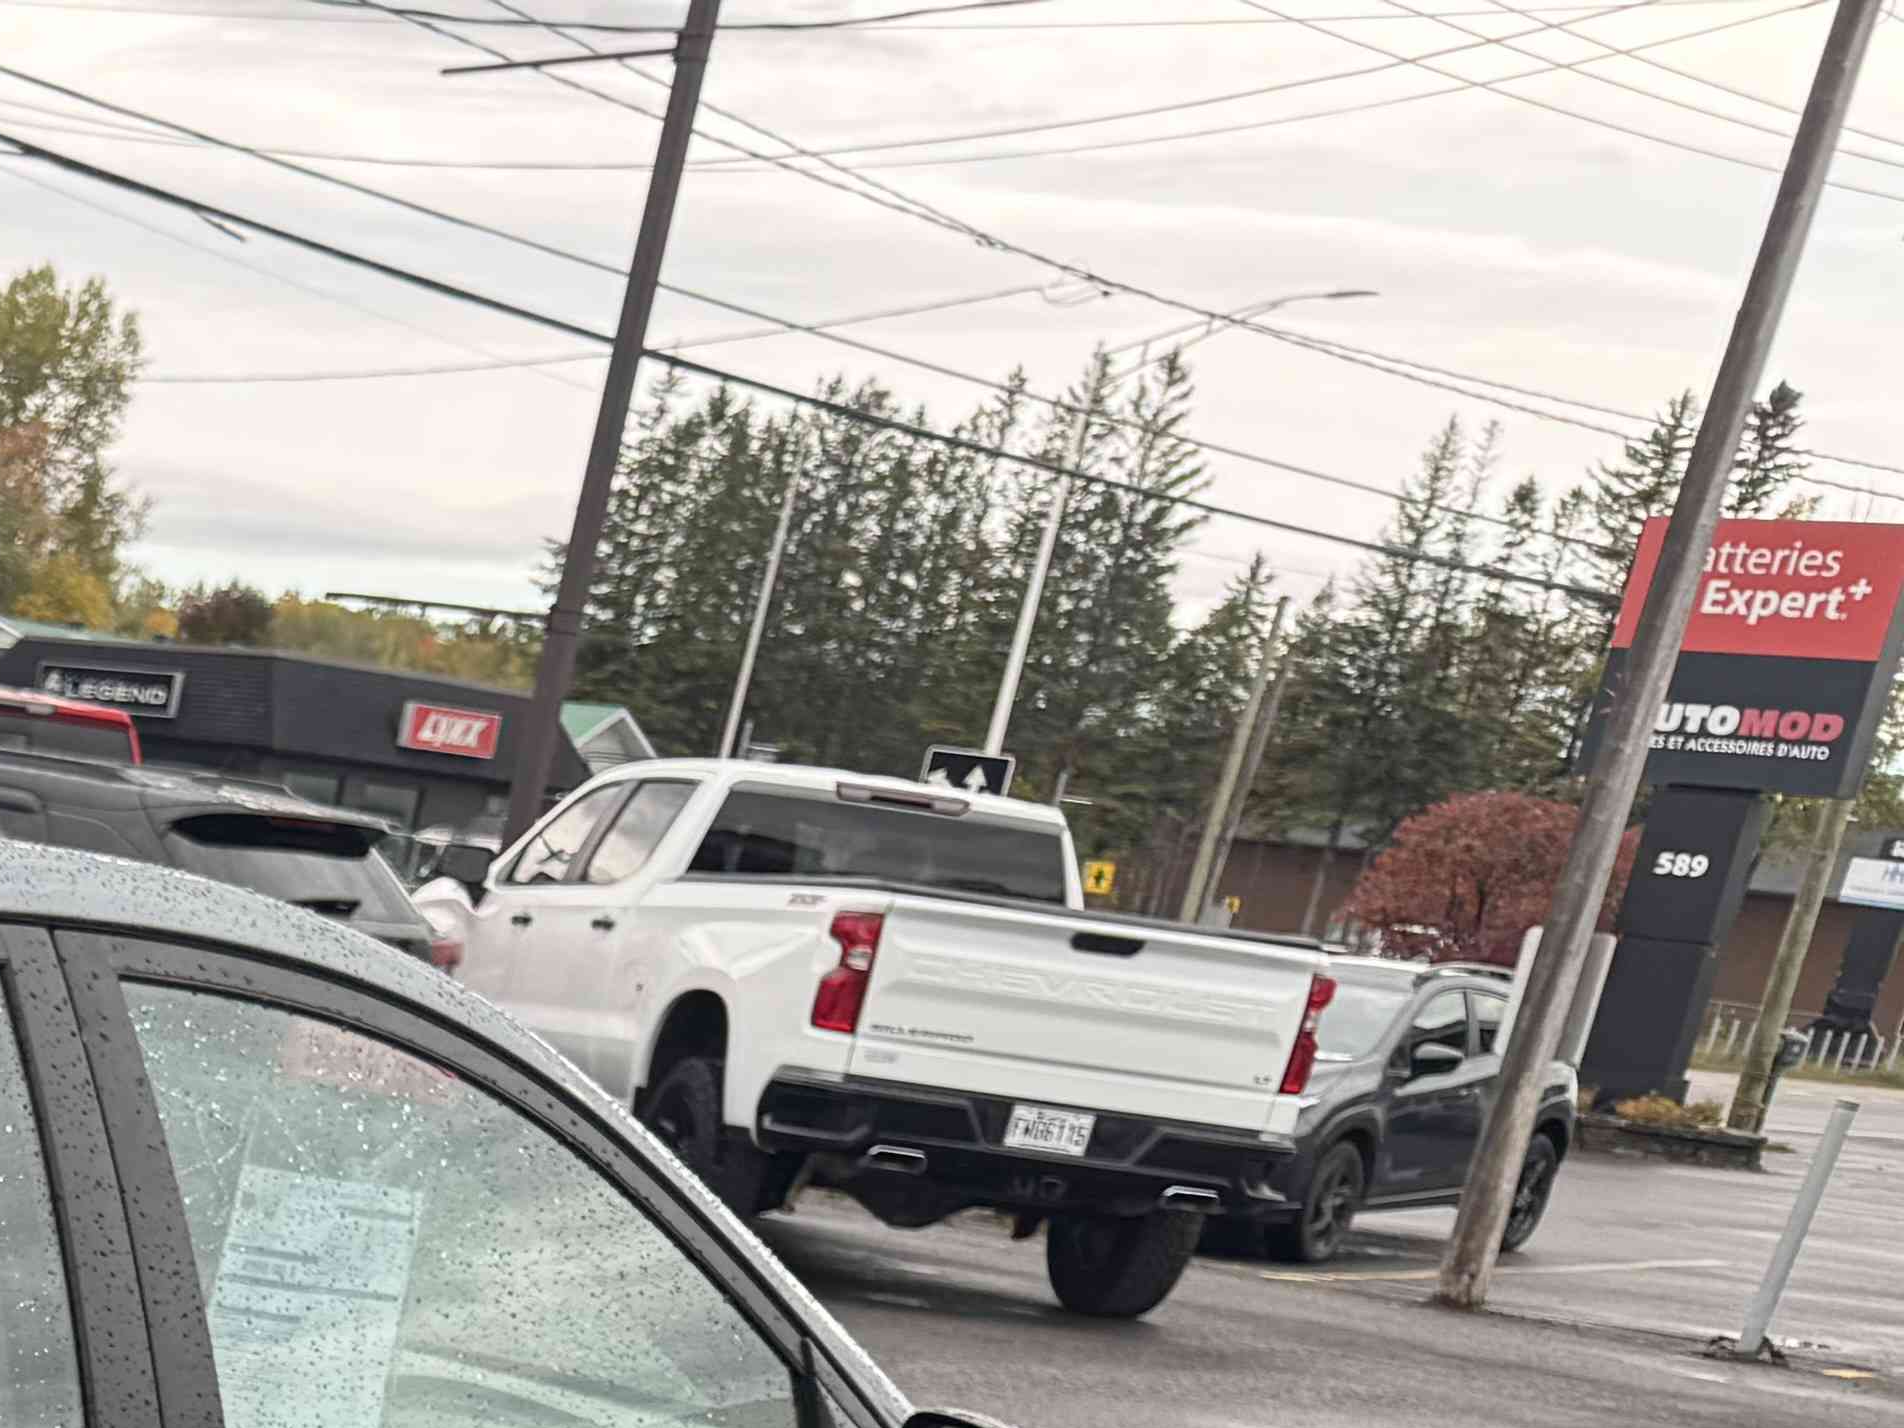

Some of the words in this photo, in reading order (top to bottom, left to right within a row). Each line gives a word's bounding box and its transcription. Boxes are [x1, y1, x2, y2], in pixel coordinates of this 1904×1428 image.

[1703, 540, 1844, 578] atteries
[64, 670, 170, 705] LEGEND
[416, 710, 490, 748] LYNX
[1654, 702, 1845, 742] UTOMOD
[1652, 851, 1709, 877] 589
